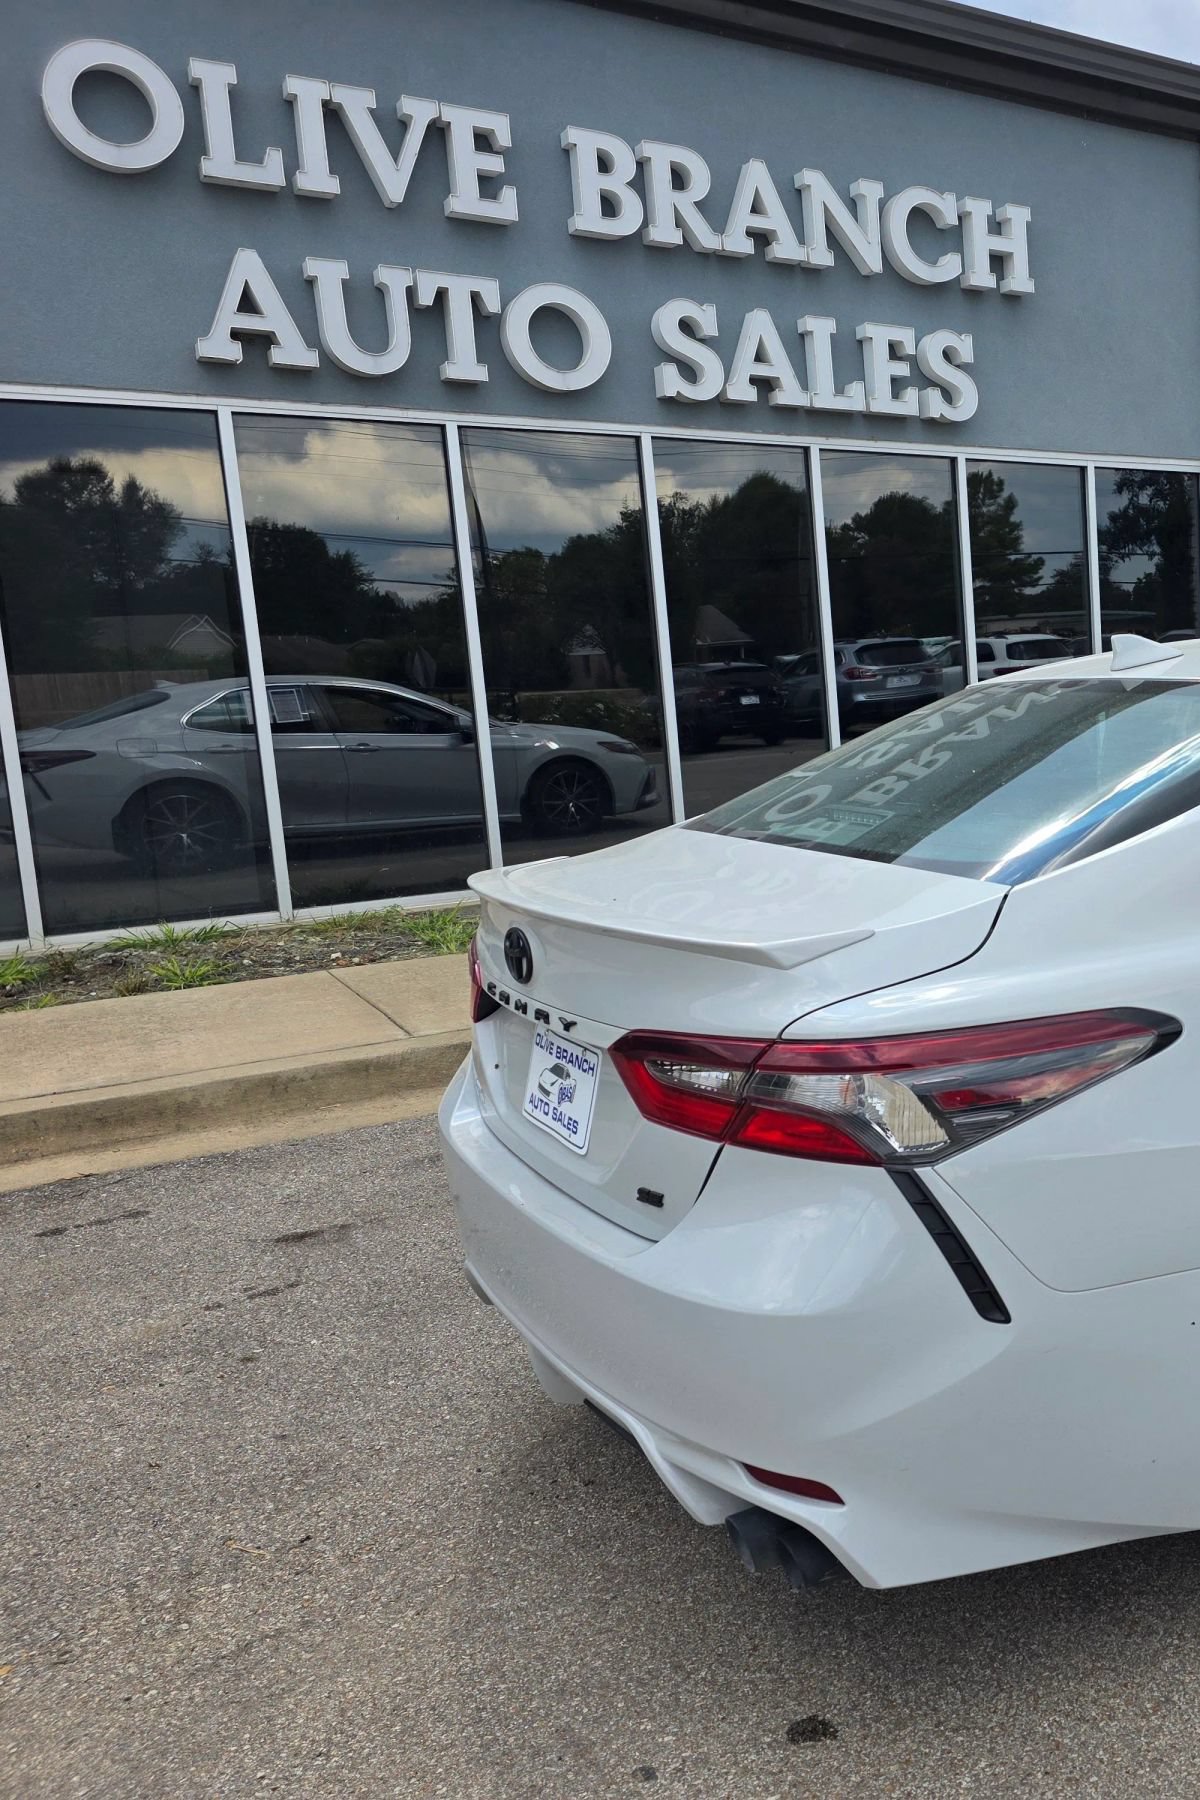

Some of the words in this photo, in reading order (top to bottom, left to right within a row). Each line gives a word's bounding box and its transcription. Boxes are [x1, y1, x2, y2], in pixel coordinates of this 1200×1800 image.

[41, 39, 519, 226] OLIVE
[561, 125, 1035, 297] BRANCH
[194, 247, 612, 393] AUTO
[651, 297, 980, 424] SALES
[487, 981, 578, 1033] CAMRY
[535, 1032, 555, 1056] OLIVE
[555, 1046, 595, 1077] BRANCH
[528, 1092, 550, 1117] AUTO
[551, 1106, 579, 1136] SALES
